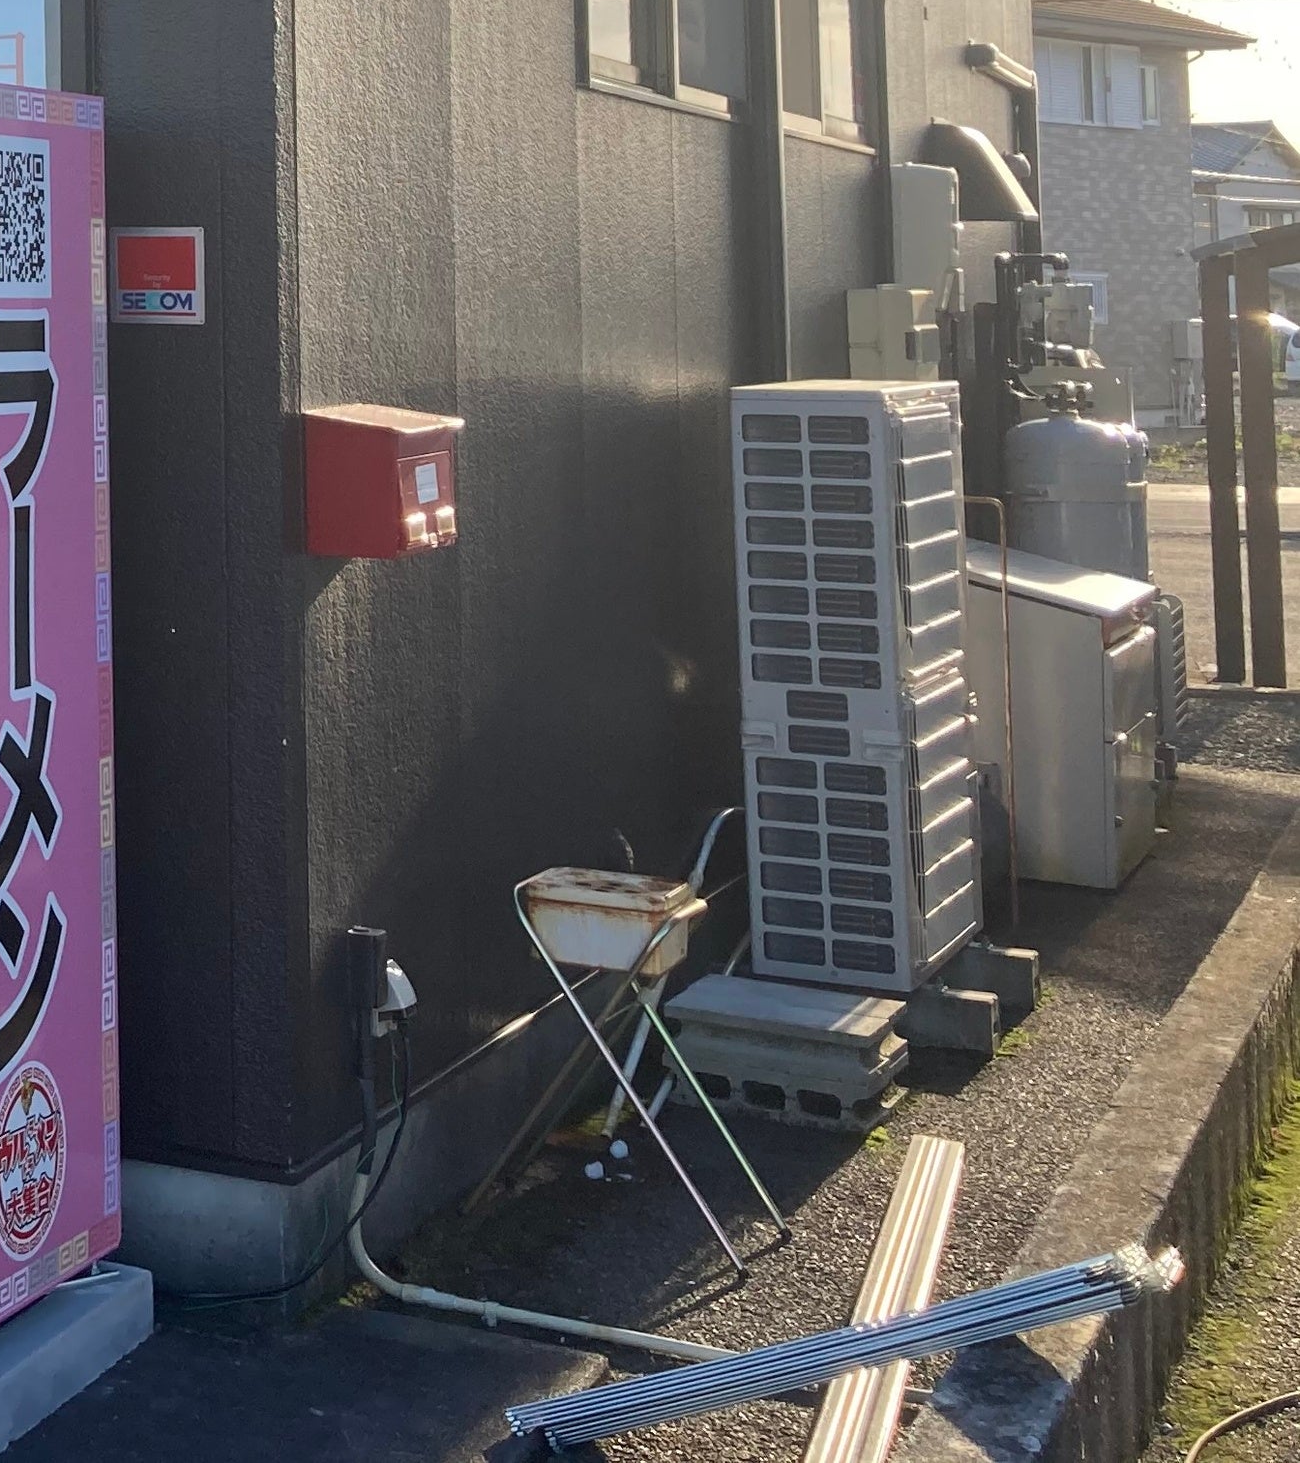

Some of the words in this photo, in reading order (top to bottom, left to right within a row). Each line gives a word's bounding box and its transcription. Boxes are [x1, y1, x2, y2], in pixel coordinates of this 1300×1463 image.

[122, 291, 193, 311] SECOM
[4, 1171, 53, 1234] 大集合
